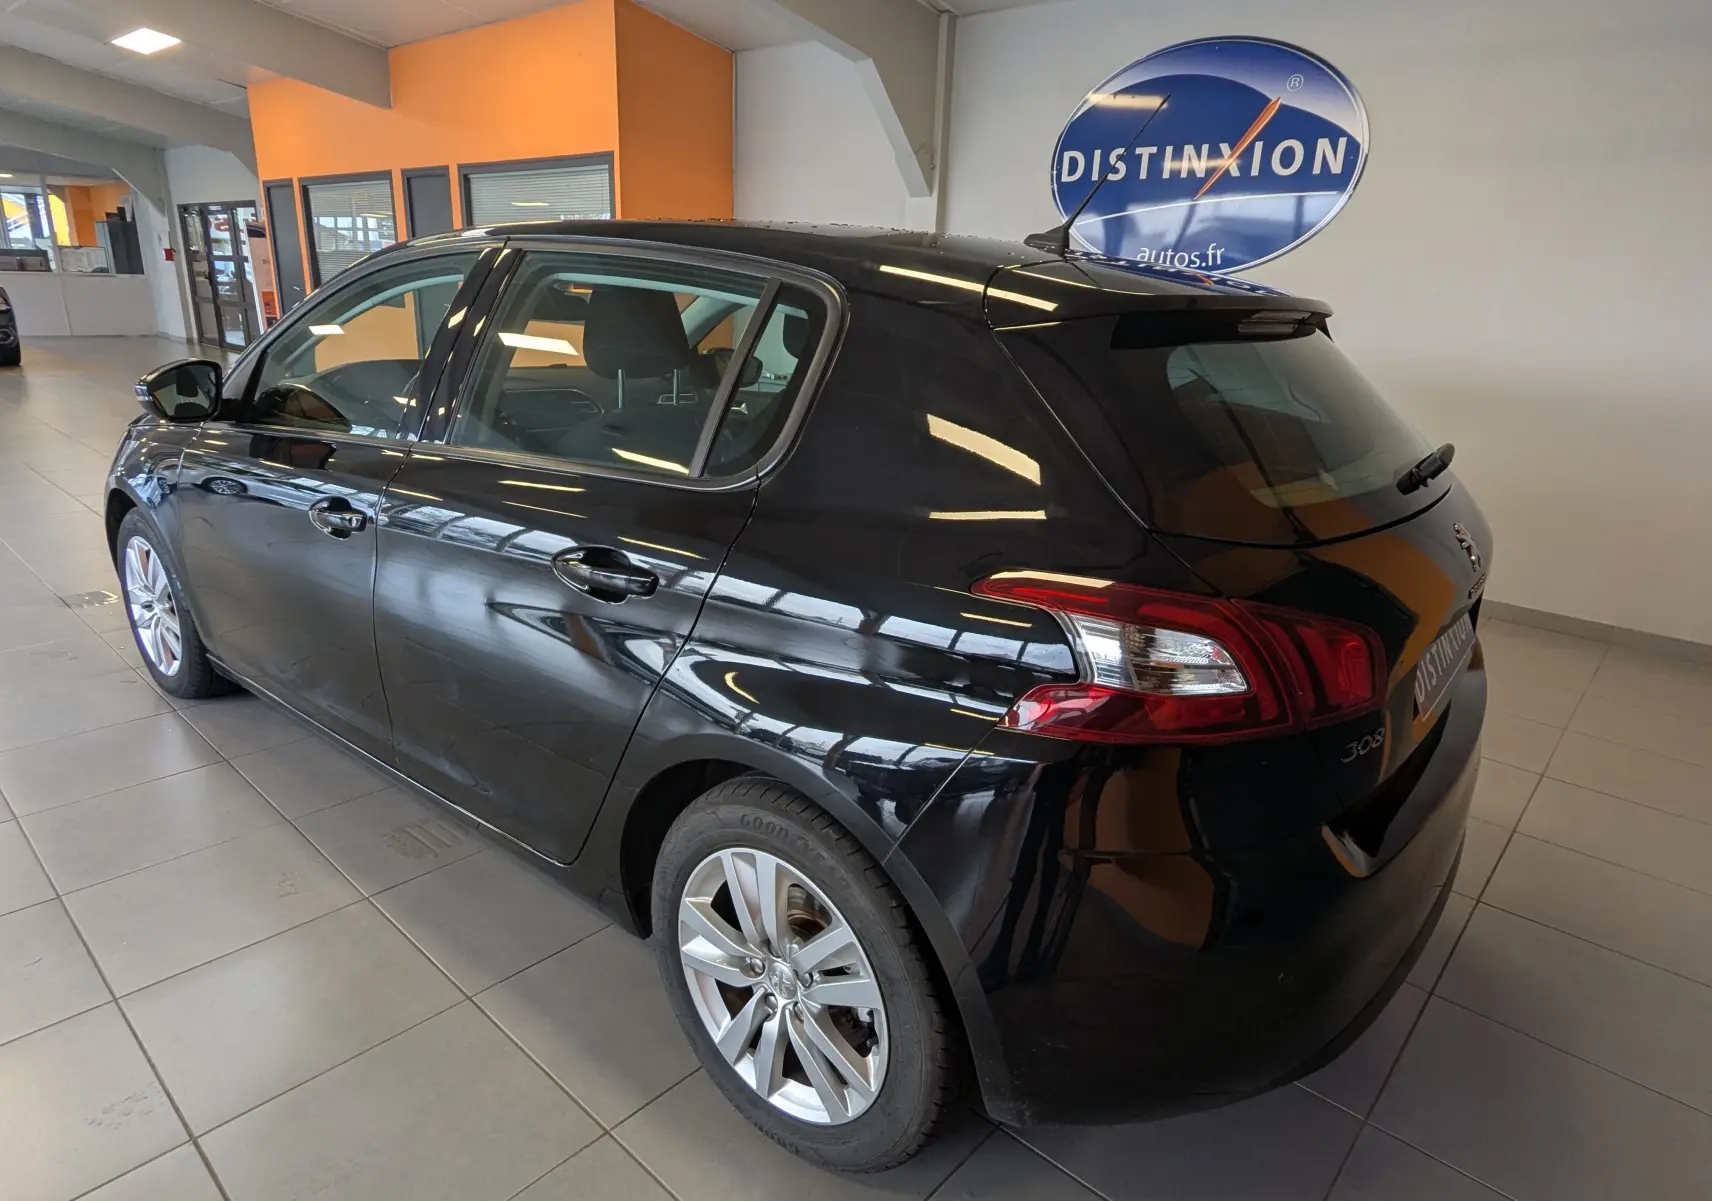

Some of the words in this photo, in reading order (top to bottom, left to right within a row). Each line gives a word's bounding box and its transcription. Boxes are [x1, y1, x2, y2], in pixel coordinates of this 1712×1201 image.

[1061, 136, 1348, 183] DISTINXION
[1137, 242, 1225, 268] autos.fr
[1340, 727, 1386, 763] 308
